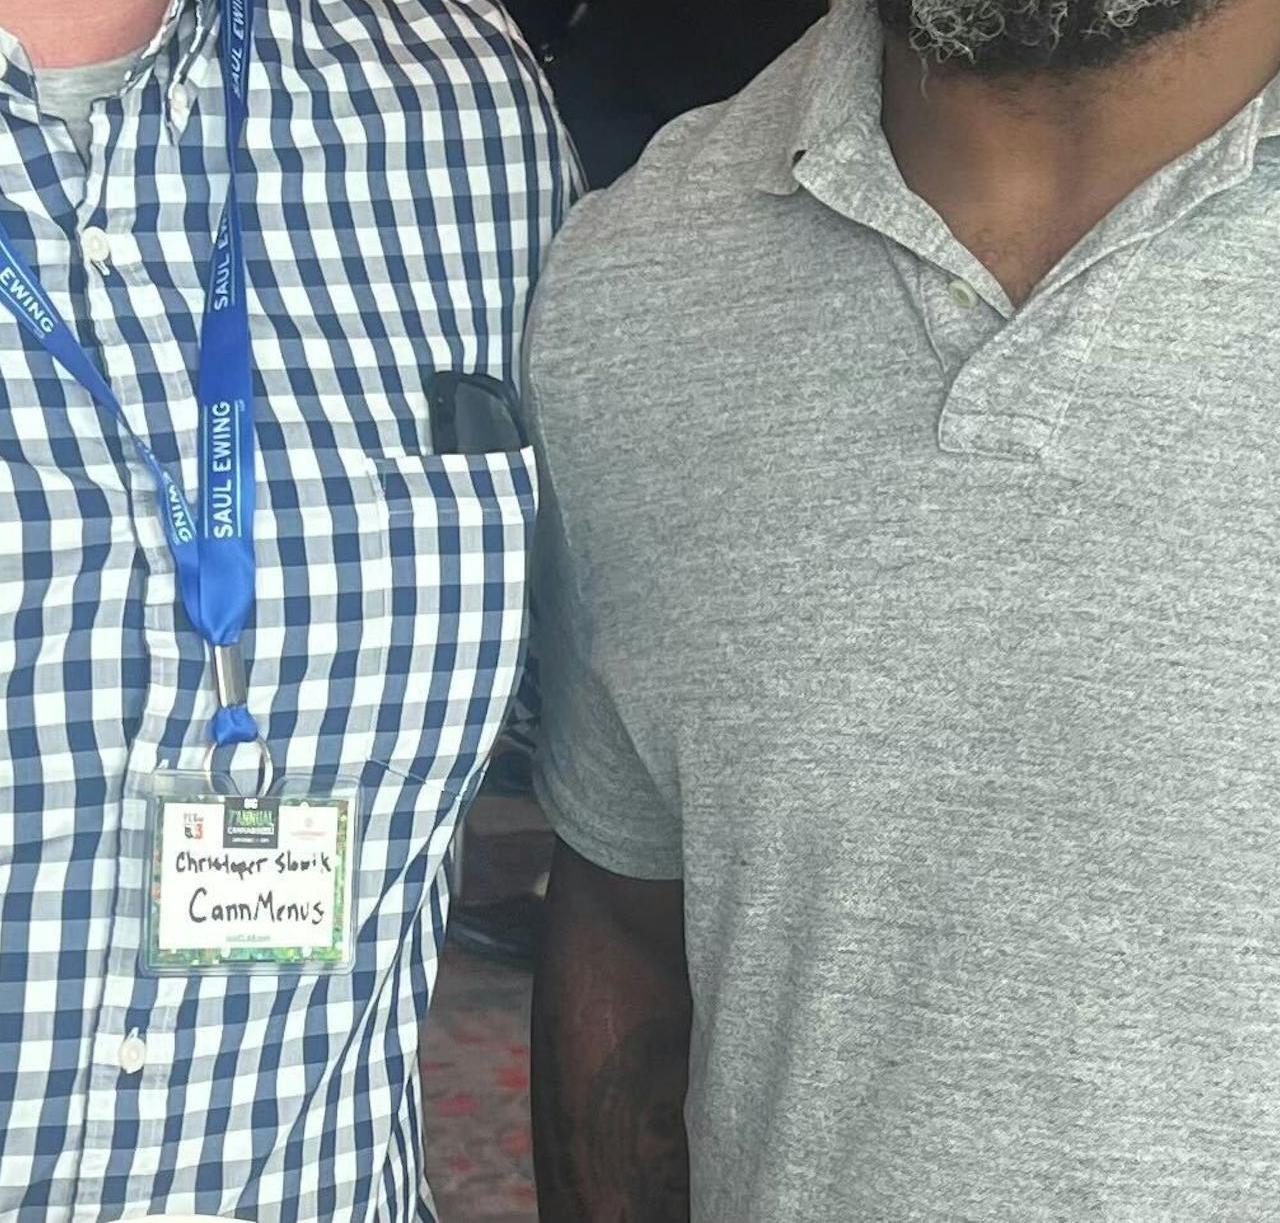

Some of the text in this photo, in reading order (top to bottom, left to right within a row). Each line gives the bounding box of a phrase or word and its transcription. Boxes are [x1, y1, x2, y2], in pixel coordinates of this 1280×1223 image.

[214, 252, 230, 311] SAUL
[212, 400, 234, 539] SAUL EWING
